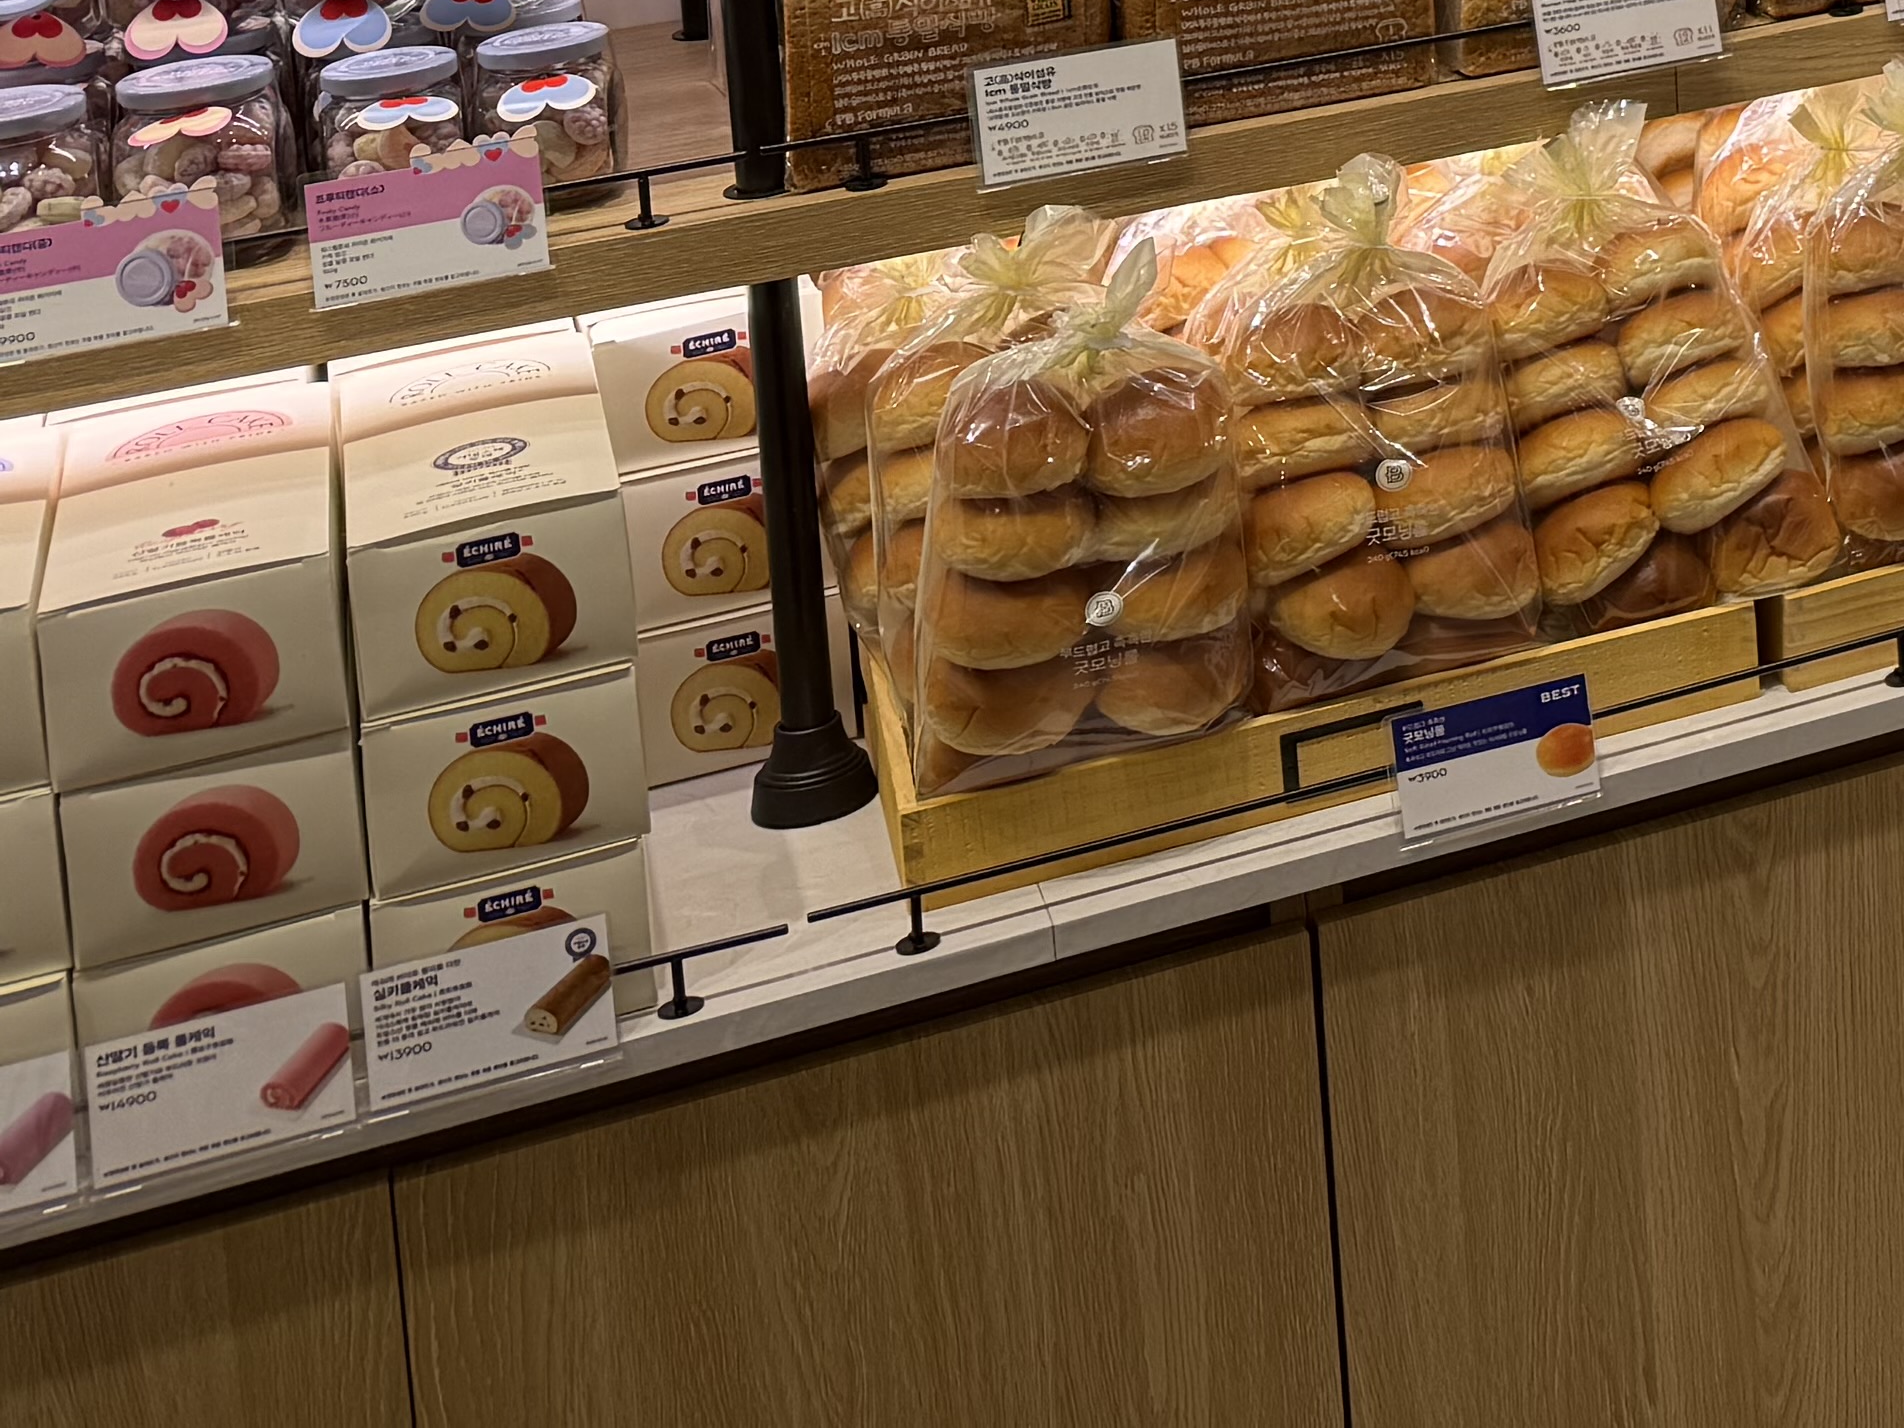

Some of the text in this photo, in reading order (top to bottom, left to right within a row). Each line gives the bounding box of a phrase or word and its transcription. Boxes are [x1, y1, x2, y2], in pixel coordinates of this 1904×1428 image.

[703, 479, 745, 497] ÉCHIRÉ
[1364, 520, 1429, 546] 굿모닝롤
[463, 538, 513, 558] ÉCHIRÉ
[1072, 648, 1141, 675] 굿모닝롤
[1540, 685, 1581, 704] BEST
[475, 716, 528, 740] ÉCHIRÉ
[1402, 723, 1445, 744] 굿모닝롤
[483, 890, 535, 915] ÉCHIRÉ
[97, 1042, 139, 1067] 산딸기
